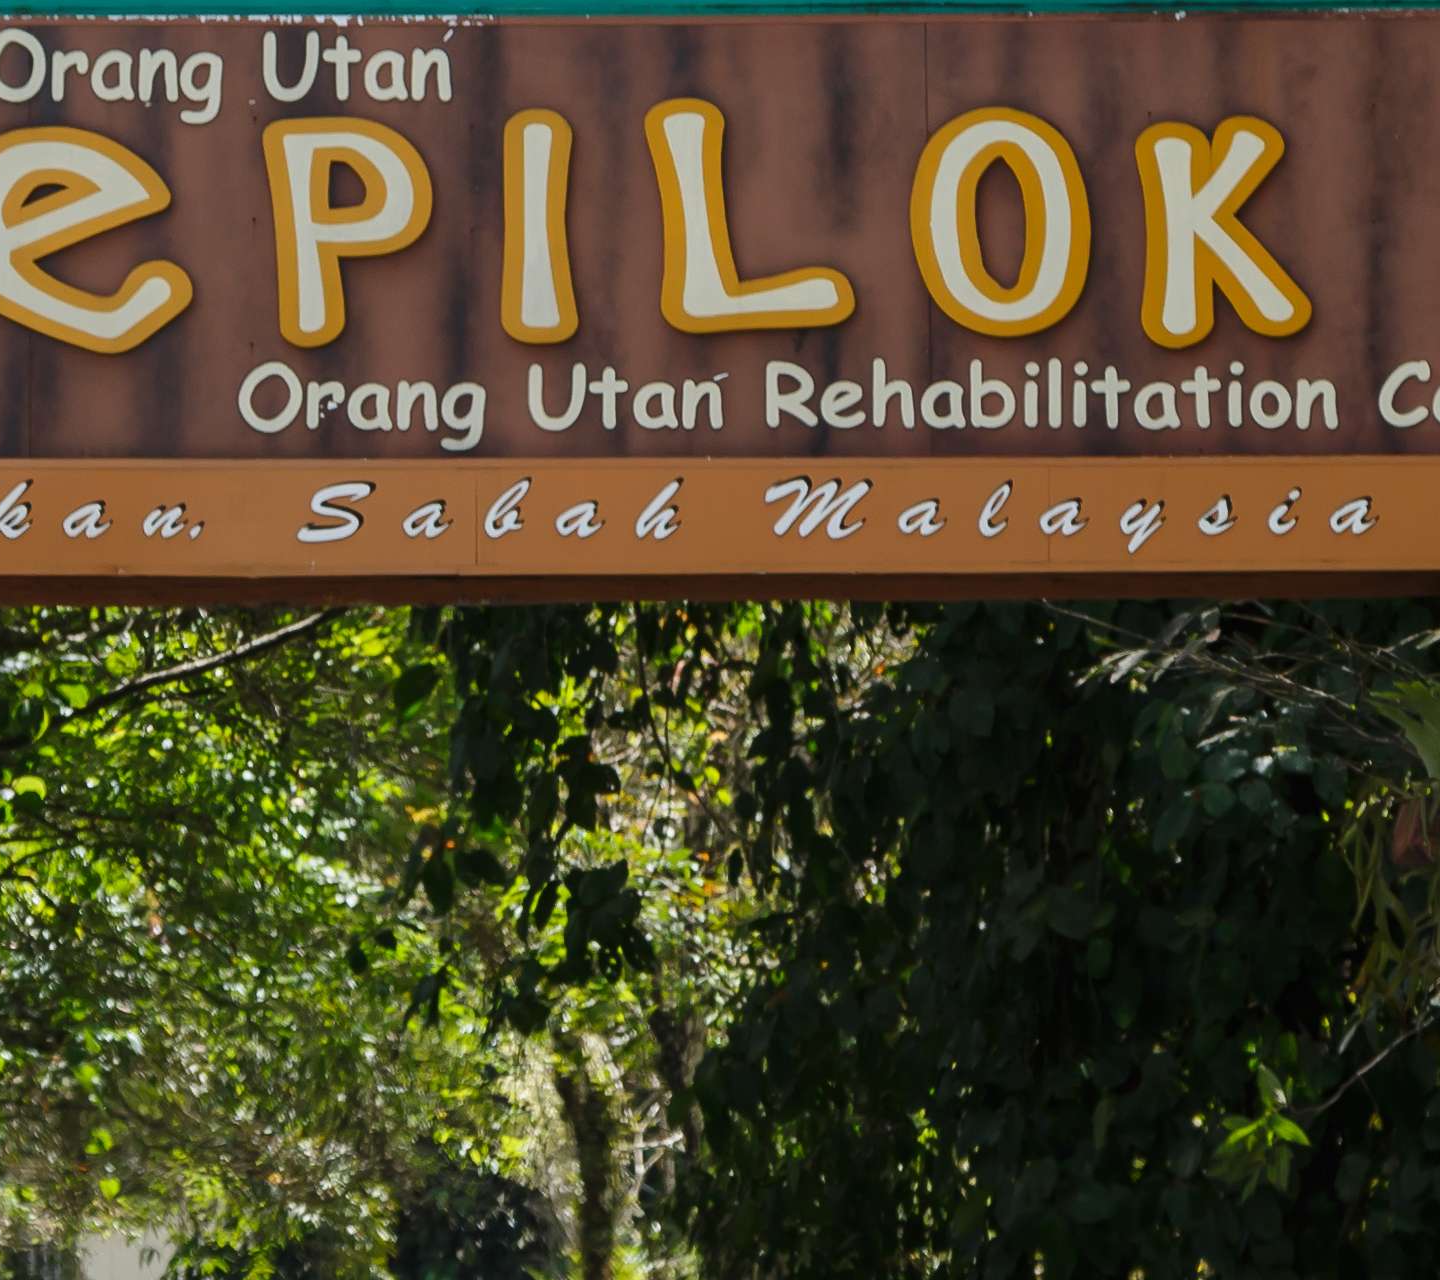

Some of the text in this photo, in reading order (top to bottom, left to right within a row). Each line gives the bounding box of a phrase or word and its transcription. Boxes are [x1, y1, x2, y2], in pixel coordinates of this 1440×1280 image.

[237, 361, 487, 450] Orang
[764, 357, 1338, 430] Rehabilitation
[296, 477, 683, 545] Sabah
[765, 474, 1378, 556] Malaysia
